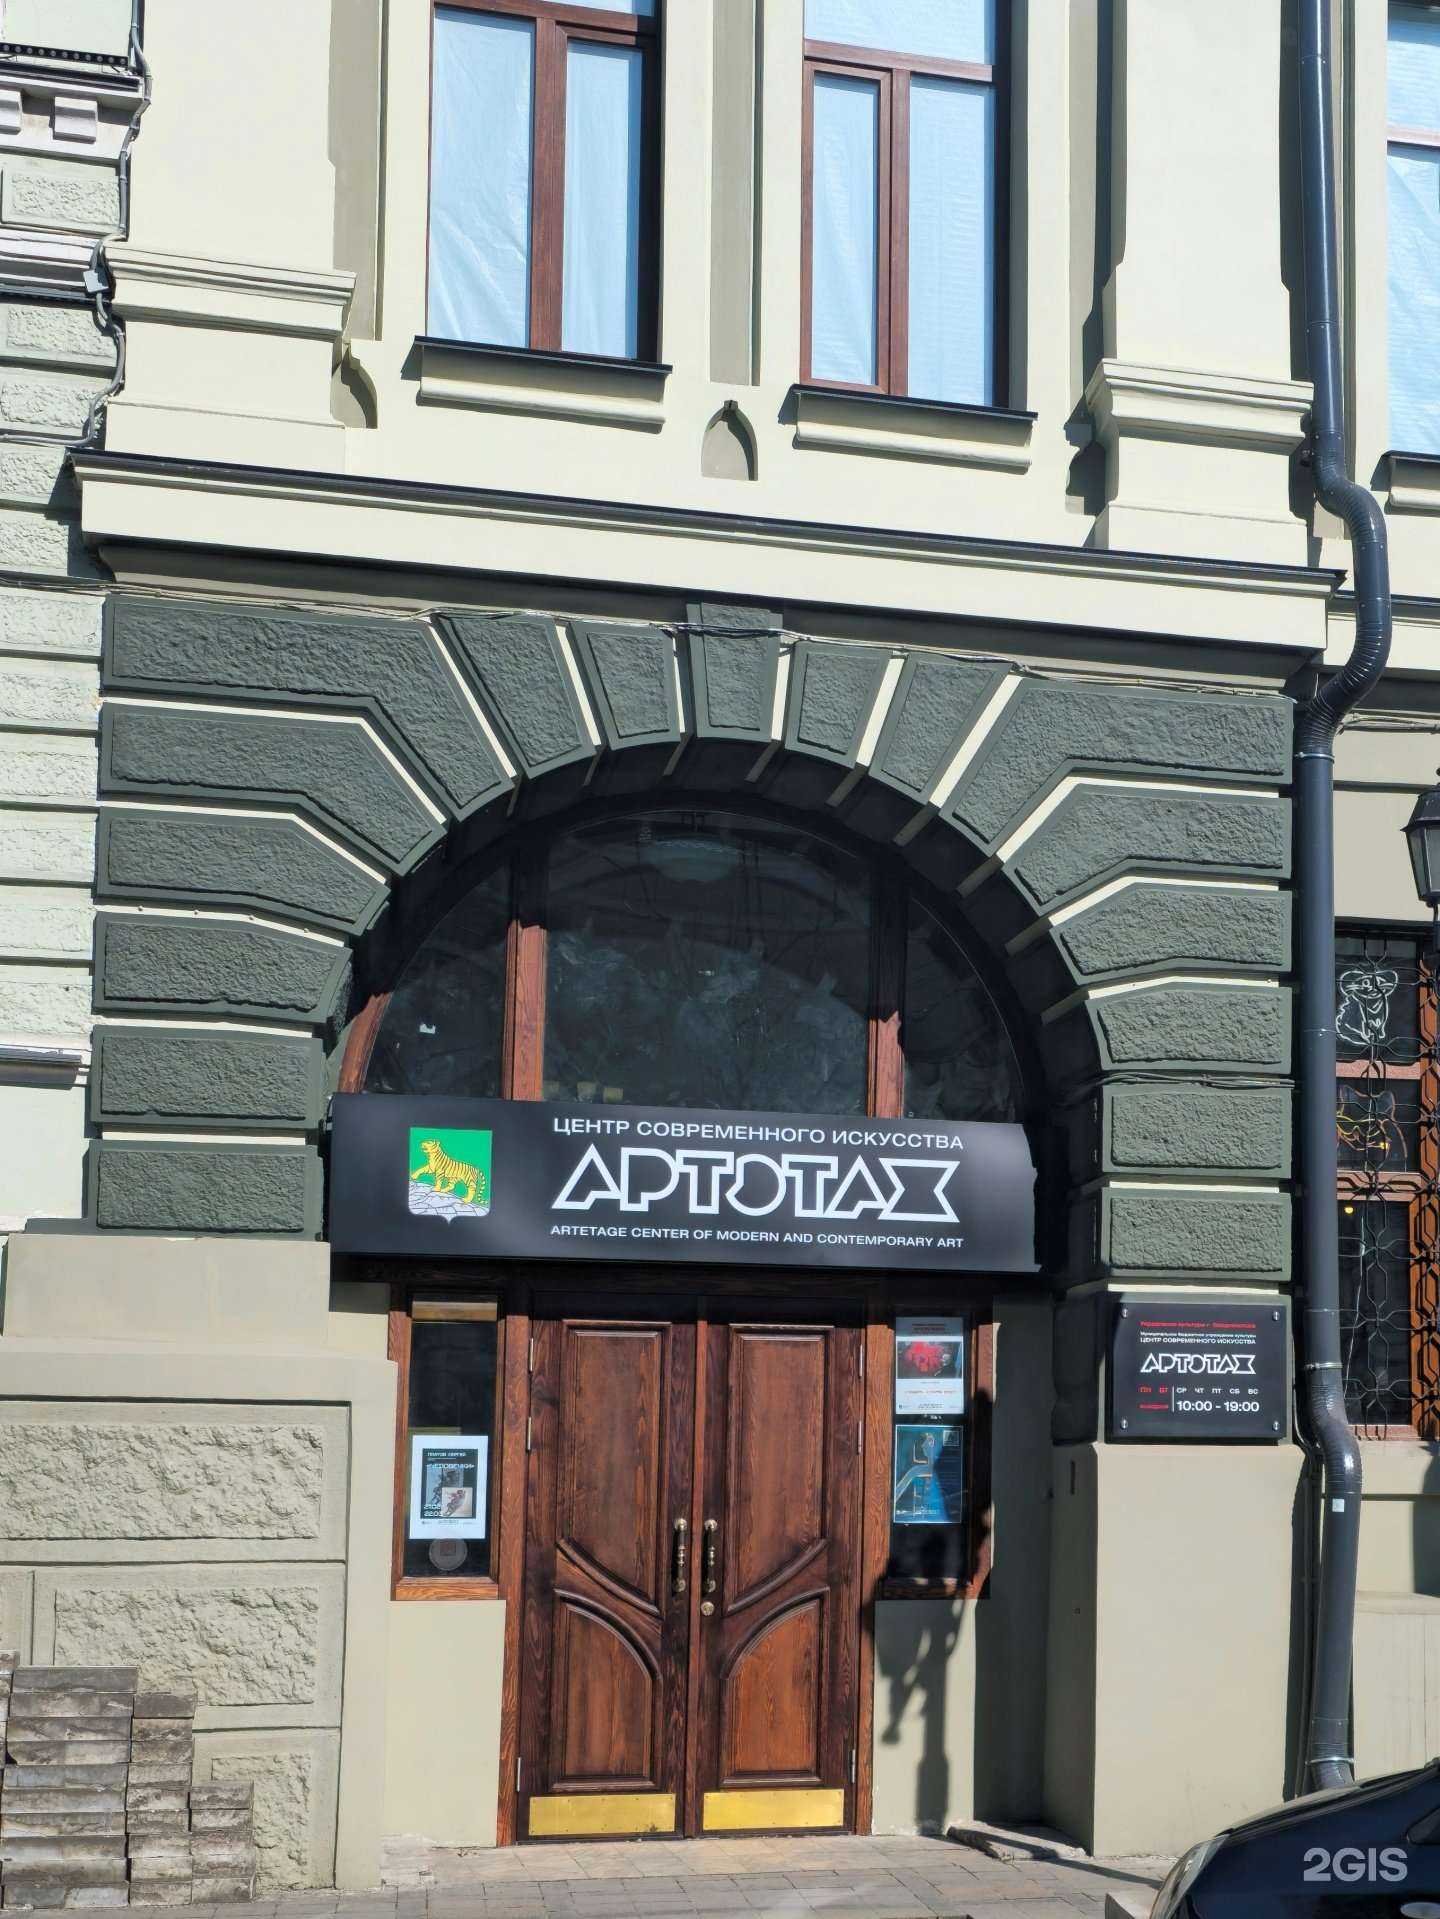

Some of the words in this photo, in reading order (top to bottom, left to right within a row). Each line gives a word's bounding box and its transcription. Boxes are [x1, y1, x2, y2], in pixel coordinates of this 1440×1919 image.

[554, 1118, 630, 1136] ЦЕНТР
[636, 1121, 826, 1144] СОВРЕМЕННОГО
[832, 1130, 964, 1150] ИСКУССТВА
[550, 1225, 628, 1238] ARTETAGE
[631, 1227, 690, 1240] CENTER
[693, 1229, 713, 1241] OF
[716, 1230, 780, 1243] MODERN
[783, 1232, 814, 1244] AND
[817, 1233, 934, 1248] CONTEMPORARY
[937, 1238, 965, 1249] ART
[1177, 1400, 1213, 1411] 10:00
[1224, 1401, 1260, 1412] 19:00
